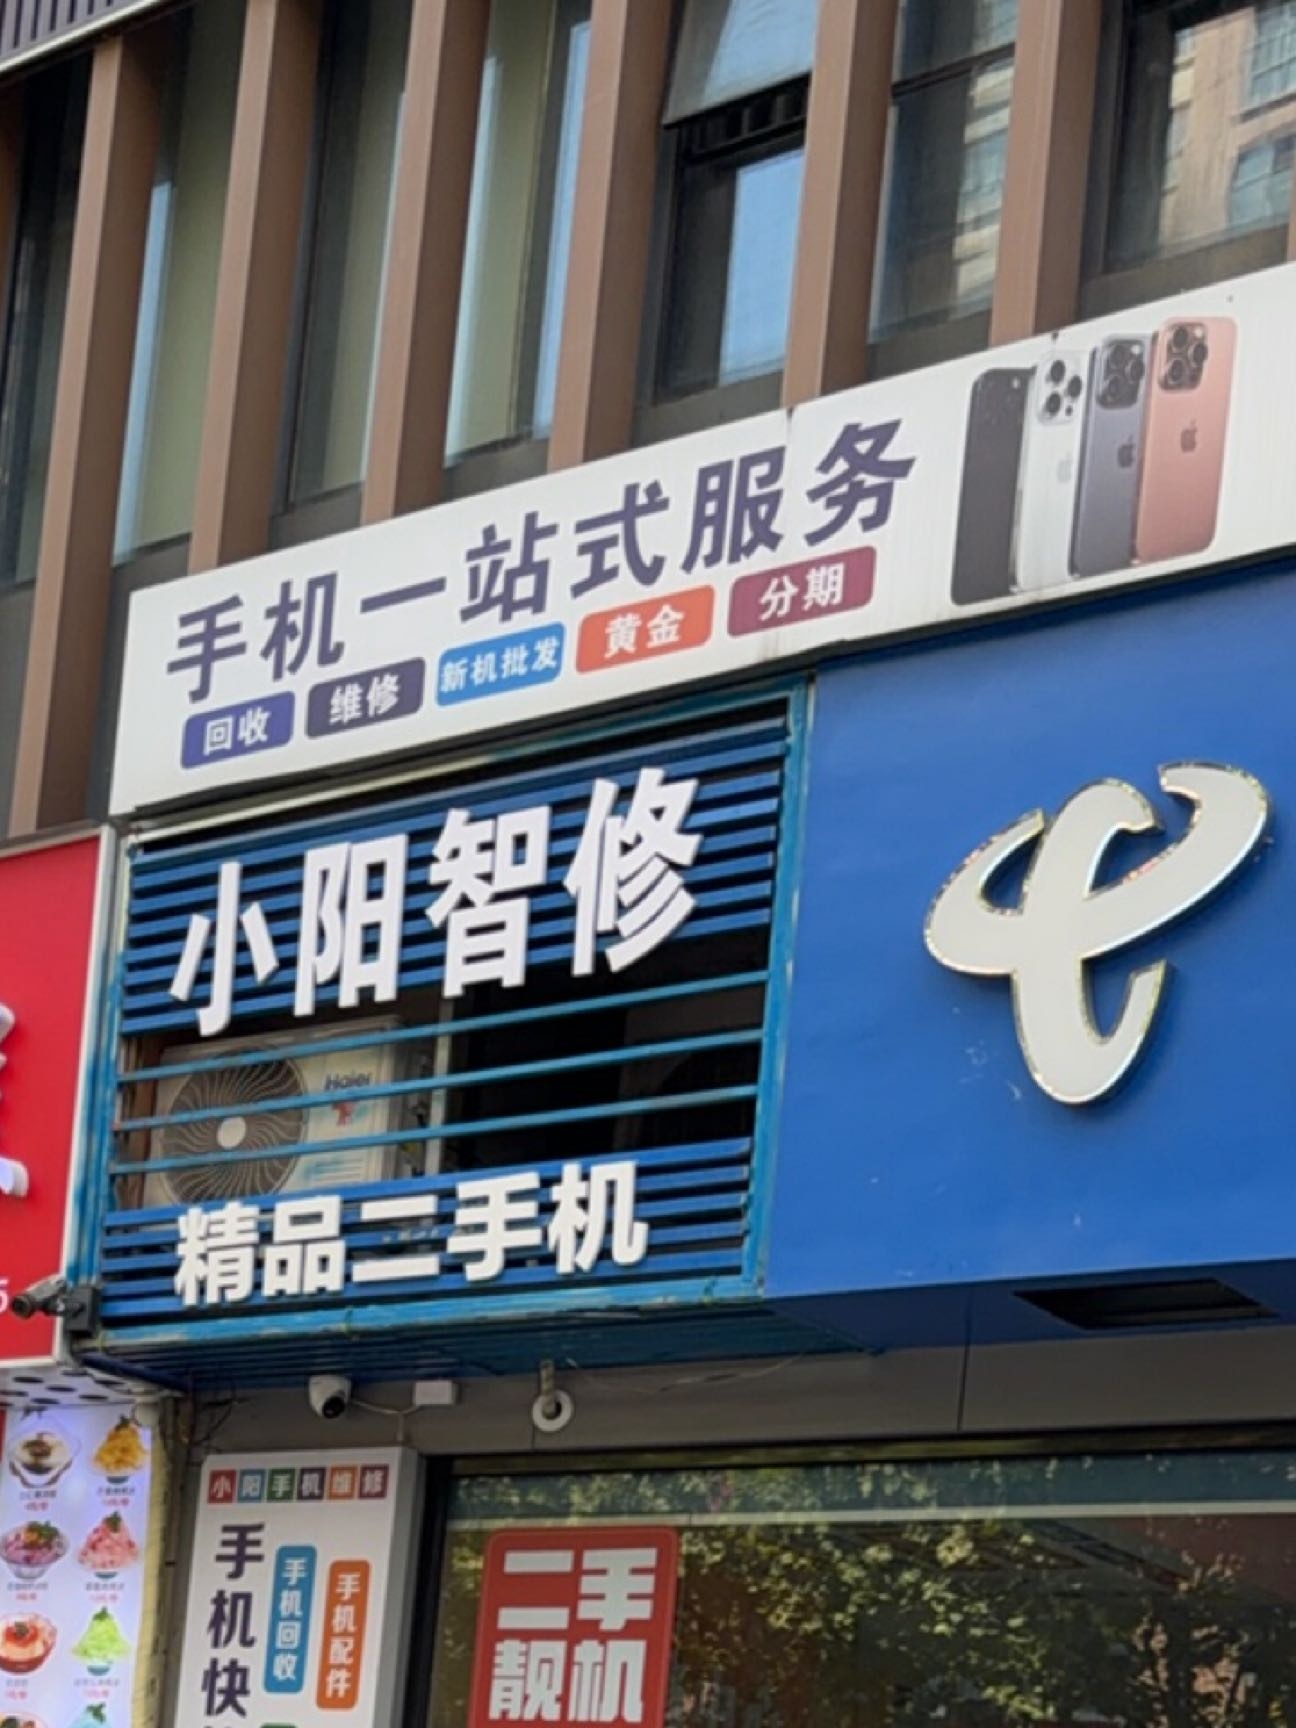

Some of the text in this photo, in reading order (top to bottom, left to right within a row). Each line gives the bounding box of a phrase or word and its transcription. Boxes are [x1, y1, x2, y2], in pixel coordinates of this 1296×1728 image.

[165, 417, 917, 705] 手机一站式服务
[202, 564, 847, 757] 回收 维修 新机批发 黄金 分期
[169, 767, 702, 1037] 小阳智修
[174, 1160, 650, 1307] 精品二手机
[210, 1467, 387, 1500] 小阳手机维修
[271, 1557, 309, 1682] 手机回收
[324, 1573, 362, 1699] 手机配件
[496, 1546, 659, 1633] 二手
[488, 1638, 645, 1725] 靓机
